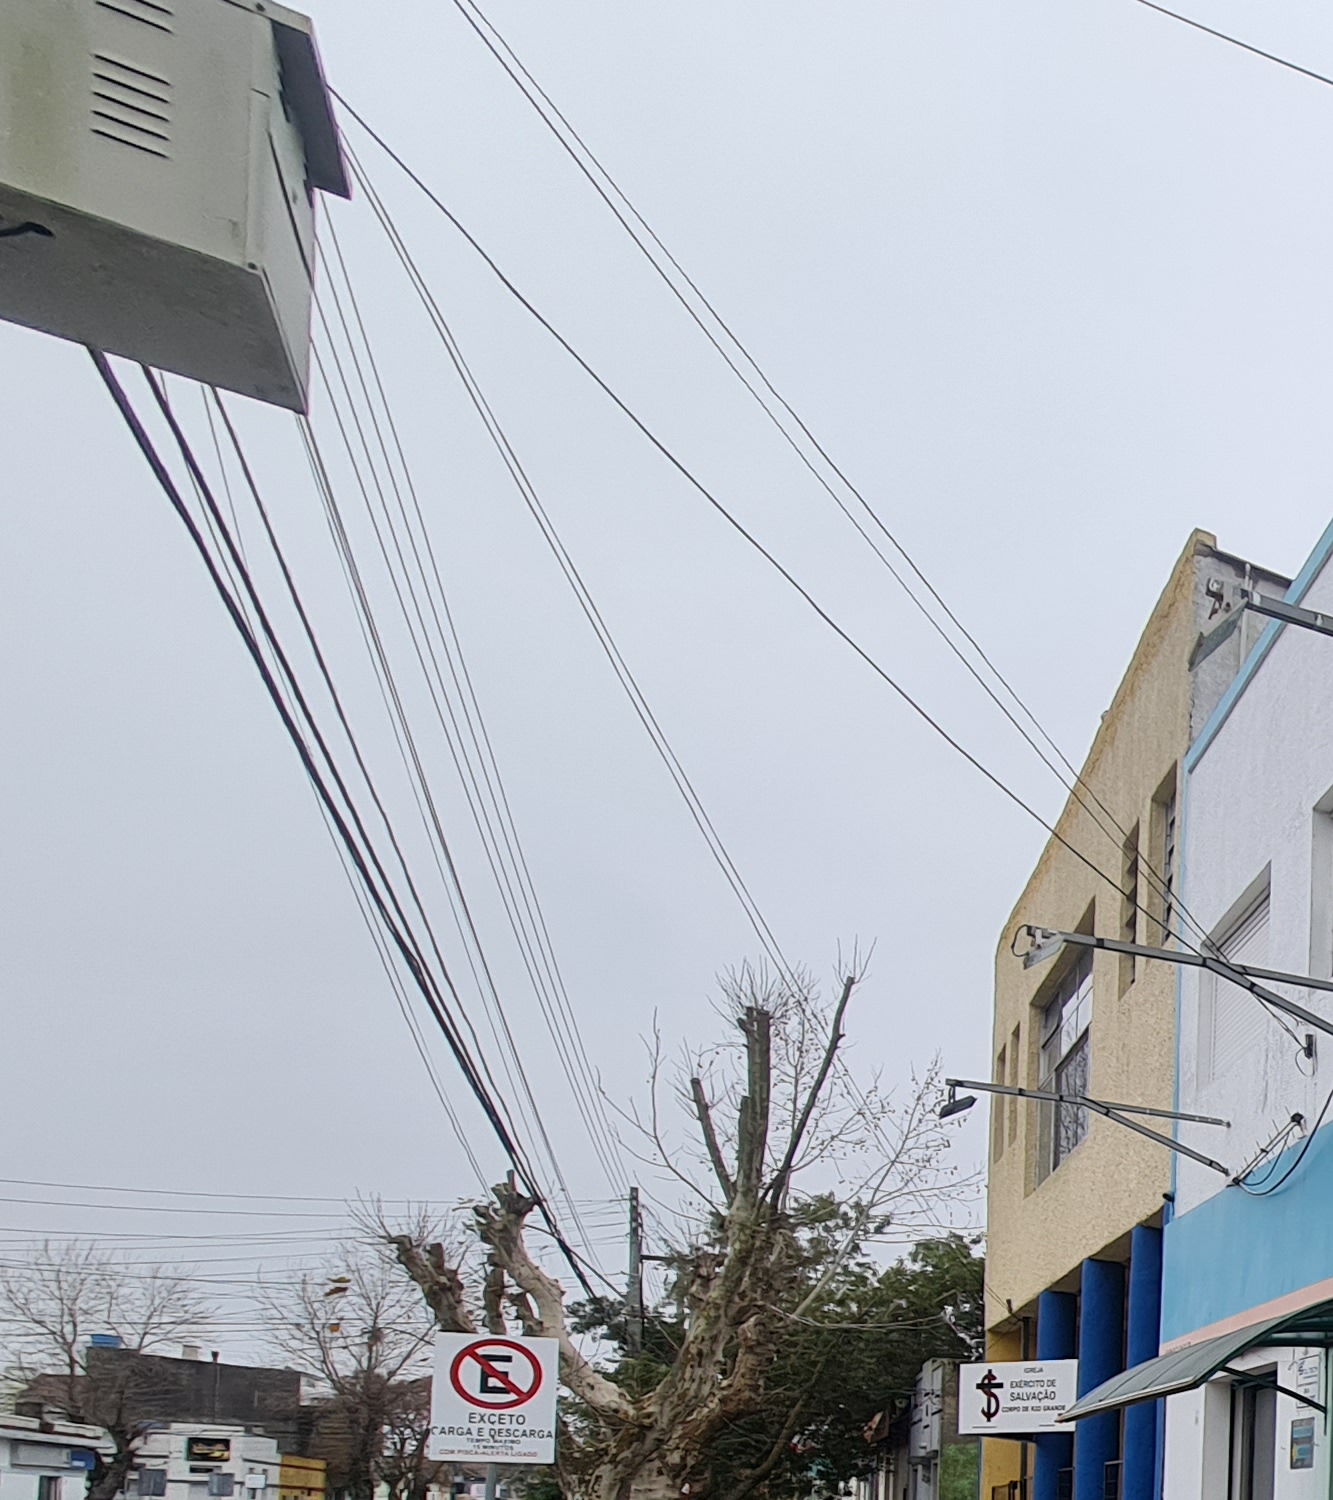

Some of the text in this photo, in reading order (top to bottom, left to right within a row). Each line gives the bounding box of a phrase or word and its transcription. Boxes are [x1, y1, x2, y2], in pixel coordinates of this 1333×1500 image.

[1010, 1379, 1057, 1389] EXÉRCITO DE
[1010, 1389, 1057, 1403] SALVAÇÃO
[468, 1412, 526, 1426] EXCETO
[477, 1427, 485, 1437] E
[488, 1427, 553, 1439] DESCARGA
